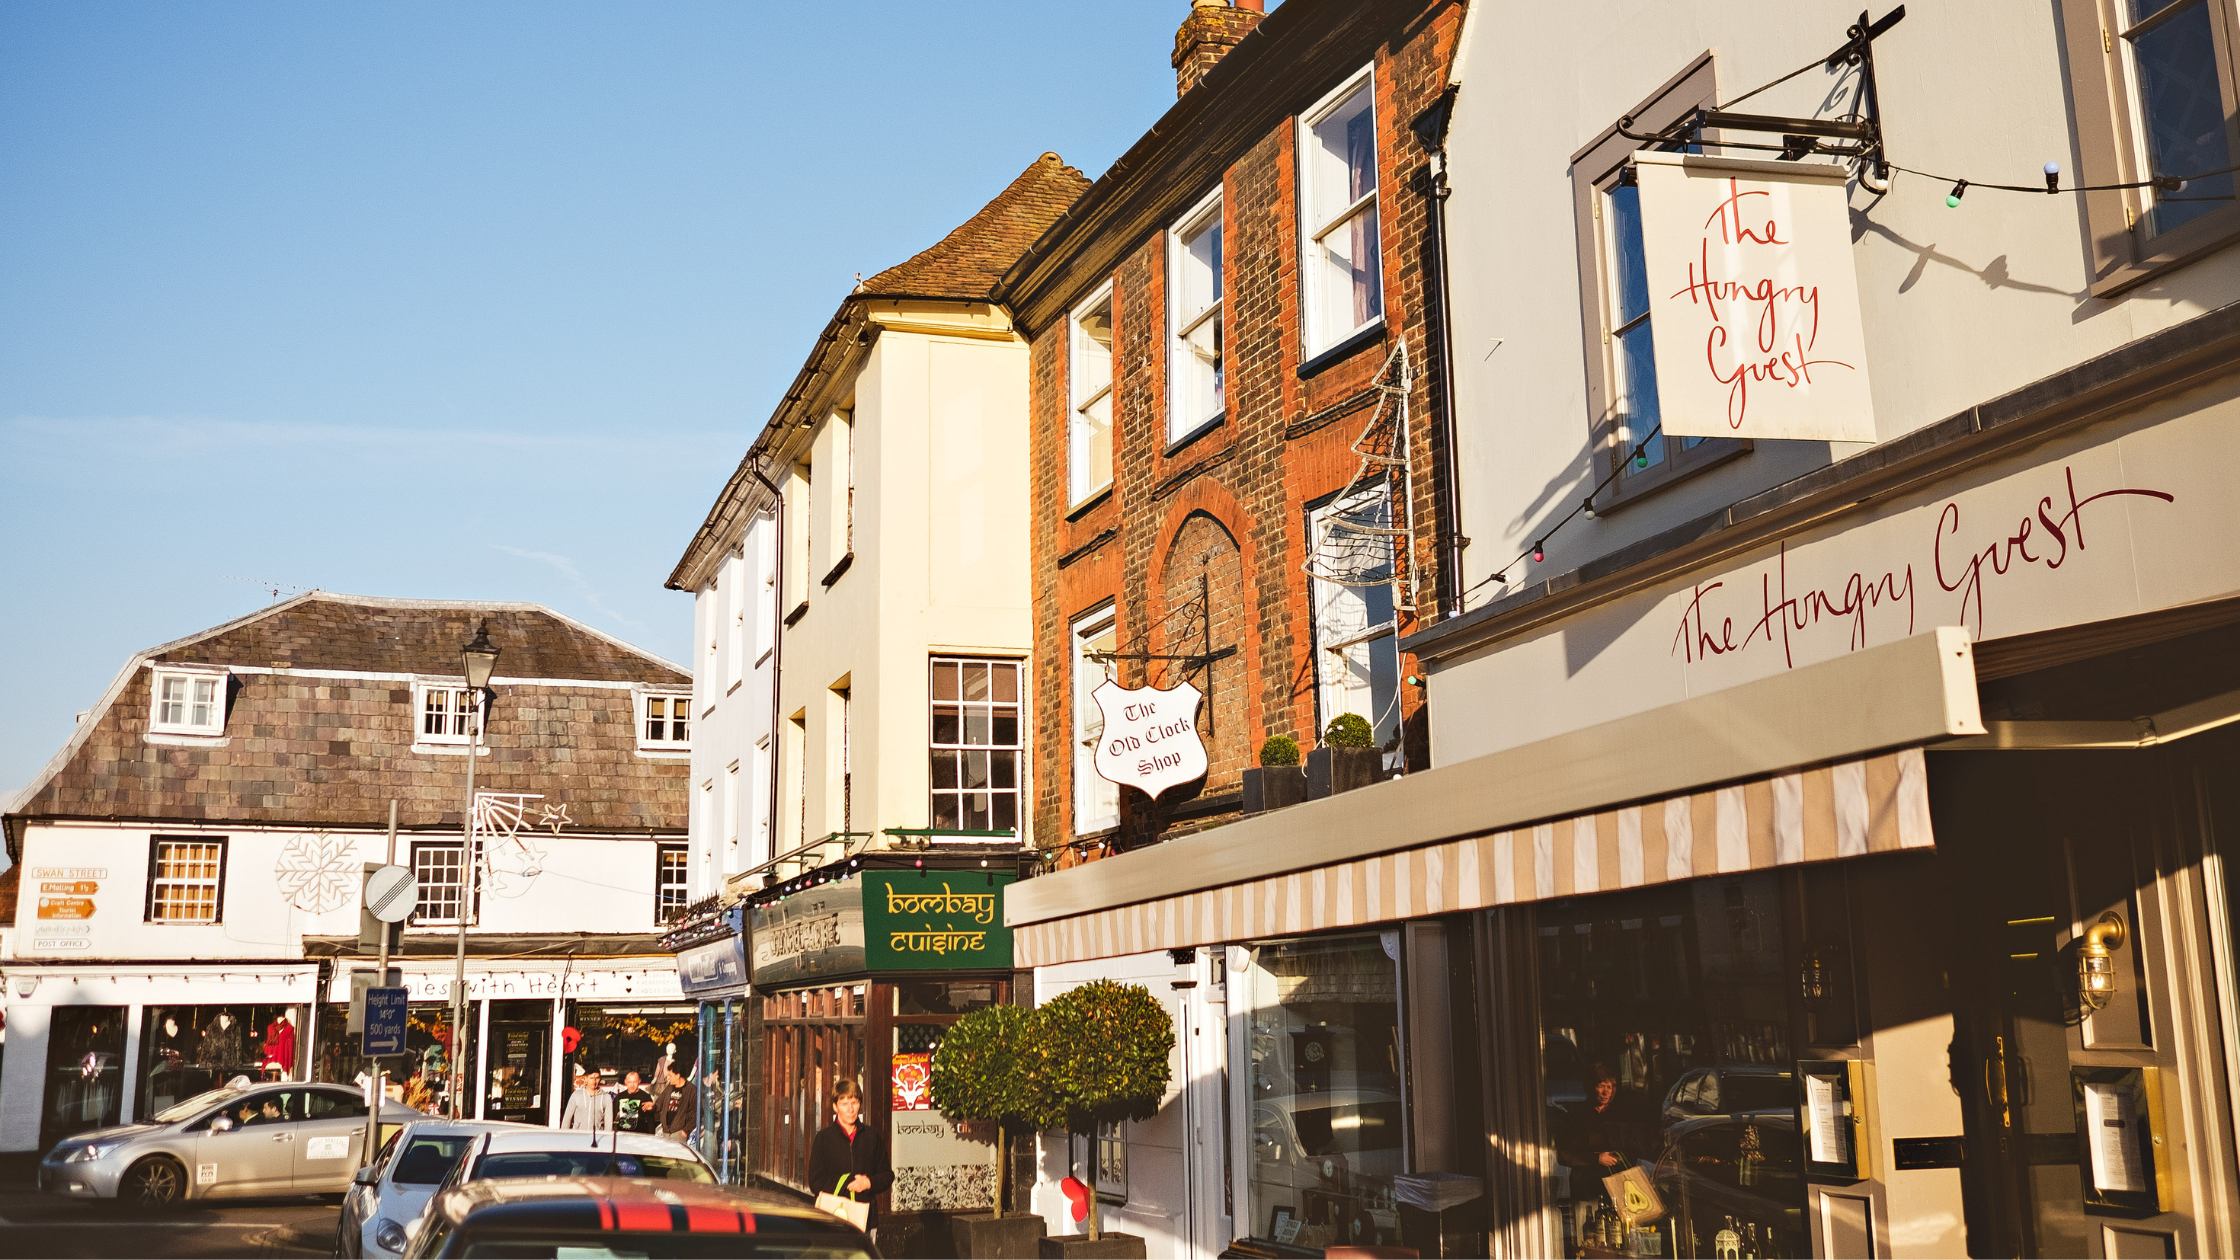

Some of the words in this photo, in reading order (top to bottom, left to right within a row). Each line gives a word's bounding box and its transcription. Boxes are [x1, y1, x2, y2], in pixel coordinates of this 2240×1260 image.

[1705, 176, 1789, 245] The
[1670, 237, 1818, 353] Hungry
[1707, 325, 1855, 430] Guest
[1672, 581, 1738, 664] The
[1741, 540, 1915, 669] Hungry
[1934, 466, 2175, 642] Guest
[1123, 702, 1156, 722] The
[1109, 736, 1141, 757] Old
[1145, 717, 1191, 743] Clock
[1137, 752, 1181, 778] Shop
[36, 868, 64, 877] SWAN
[69, 869, 104, 878] STREET
[885, 882, 996, 924] bombay
[890, 923, 987, 955] cuisine
[368, 993, 389, 1008] Height
[390, 994, 406, 1006] Limit
[401, 980, 449, 995] oles
[529, 977, 599, 995] Heart
[370, 1024, 383, 1036] 500
[384, 1024, 401, 1038] yards
[896, 1120, 945, 1139] bombay
